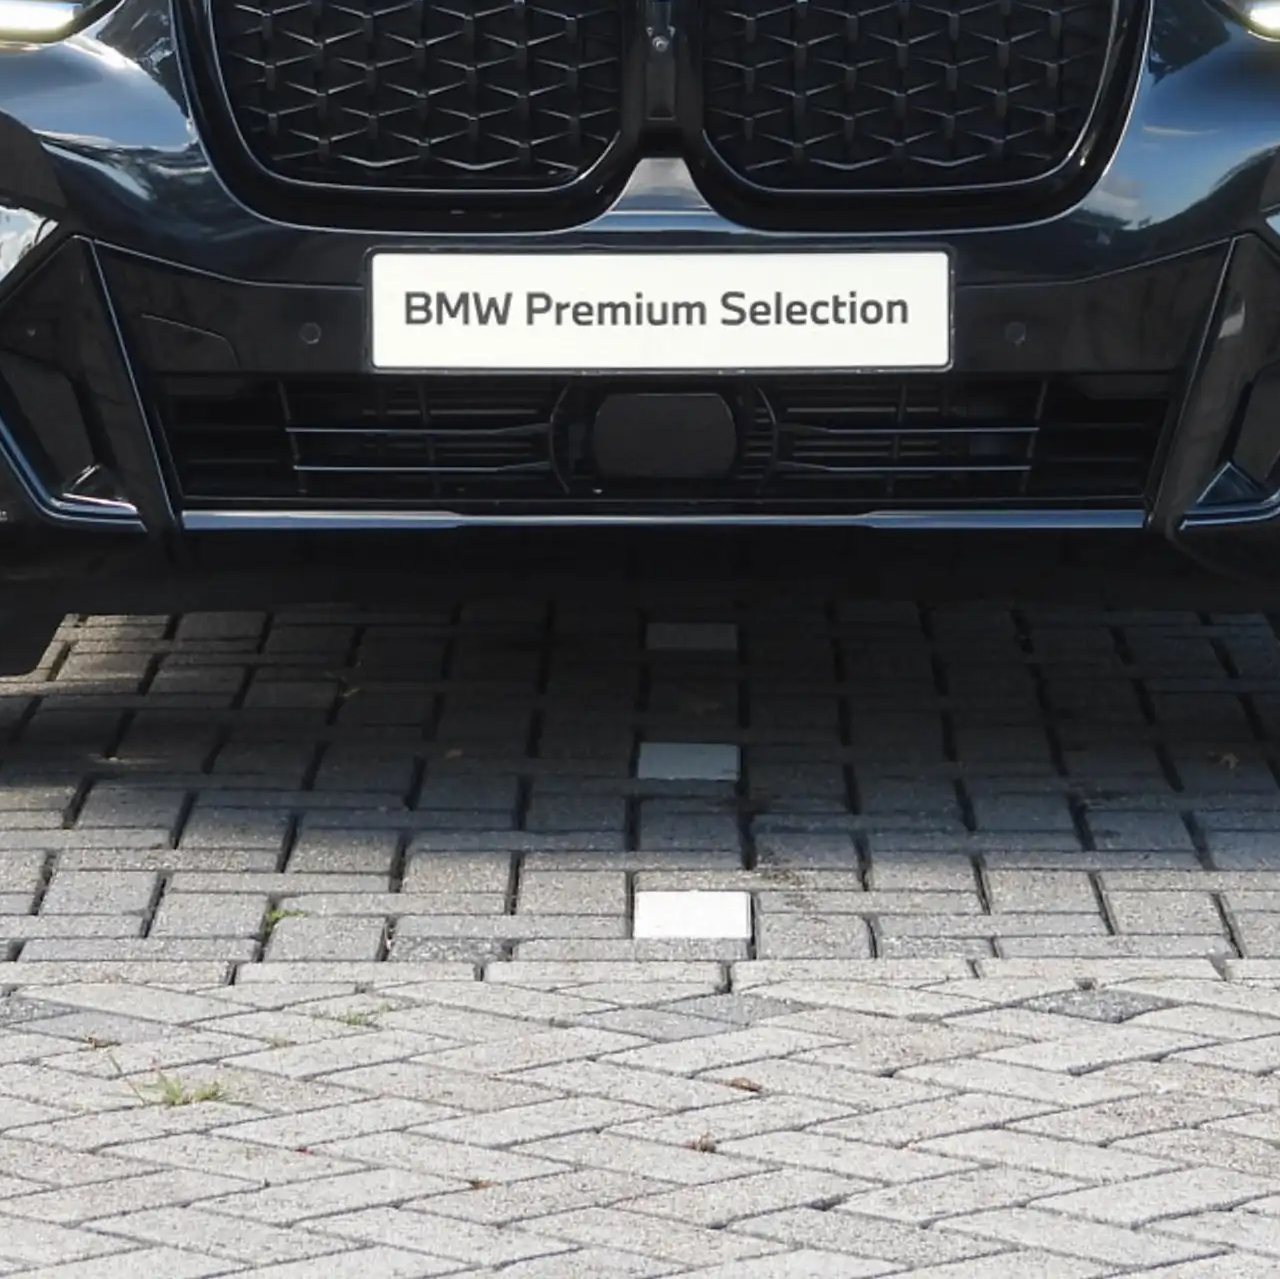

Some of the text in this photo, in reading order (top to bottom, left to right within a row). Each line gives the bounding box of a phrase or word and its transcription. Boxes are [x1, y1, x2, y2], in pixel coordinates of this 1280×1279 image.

[405, 291, 908, 326] BMW Premium Selection
